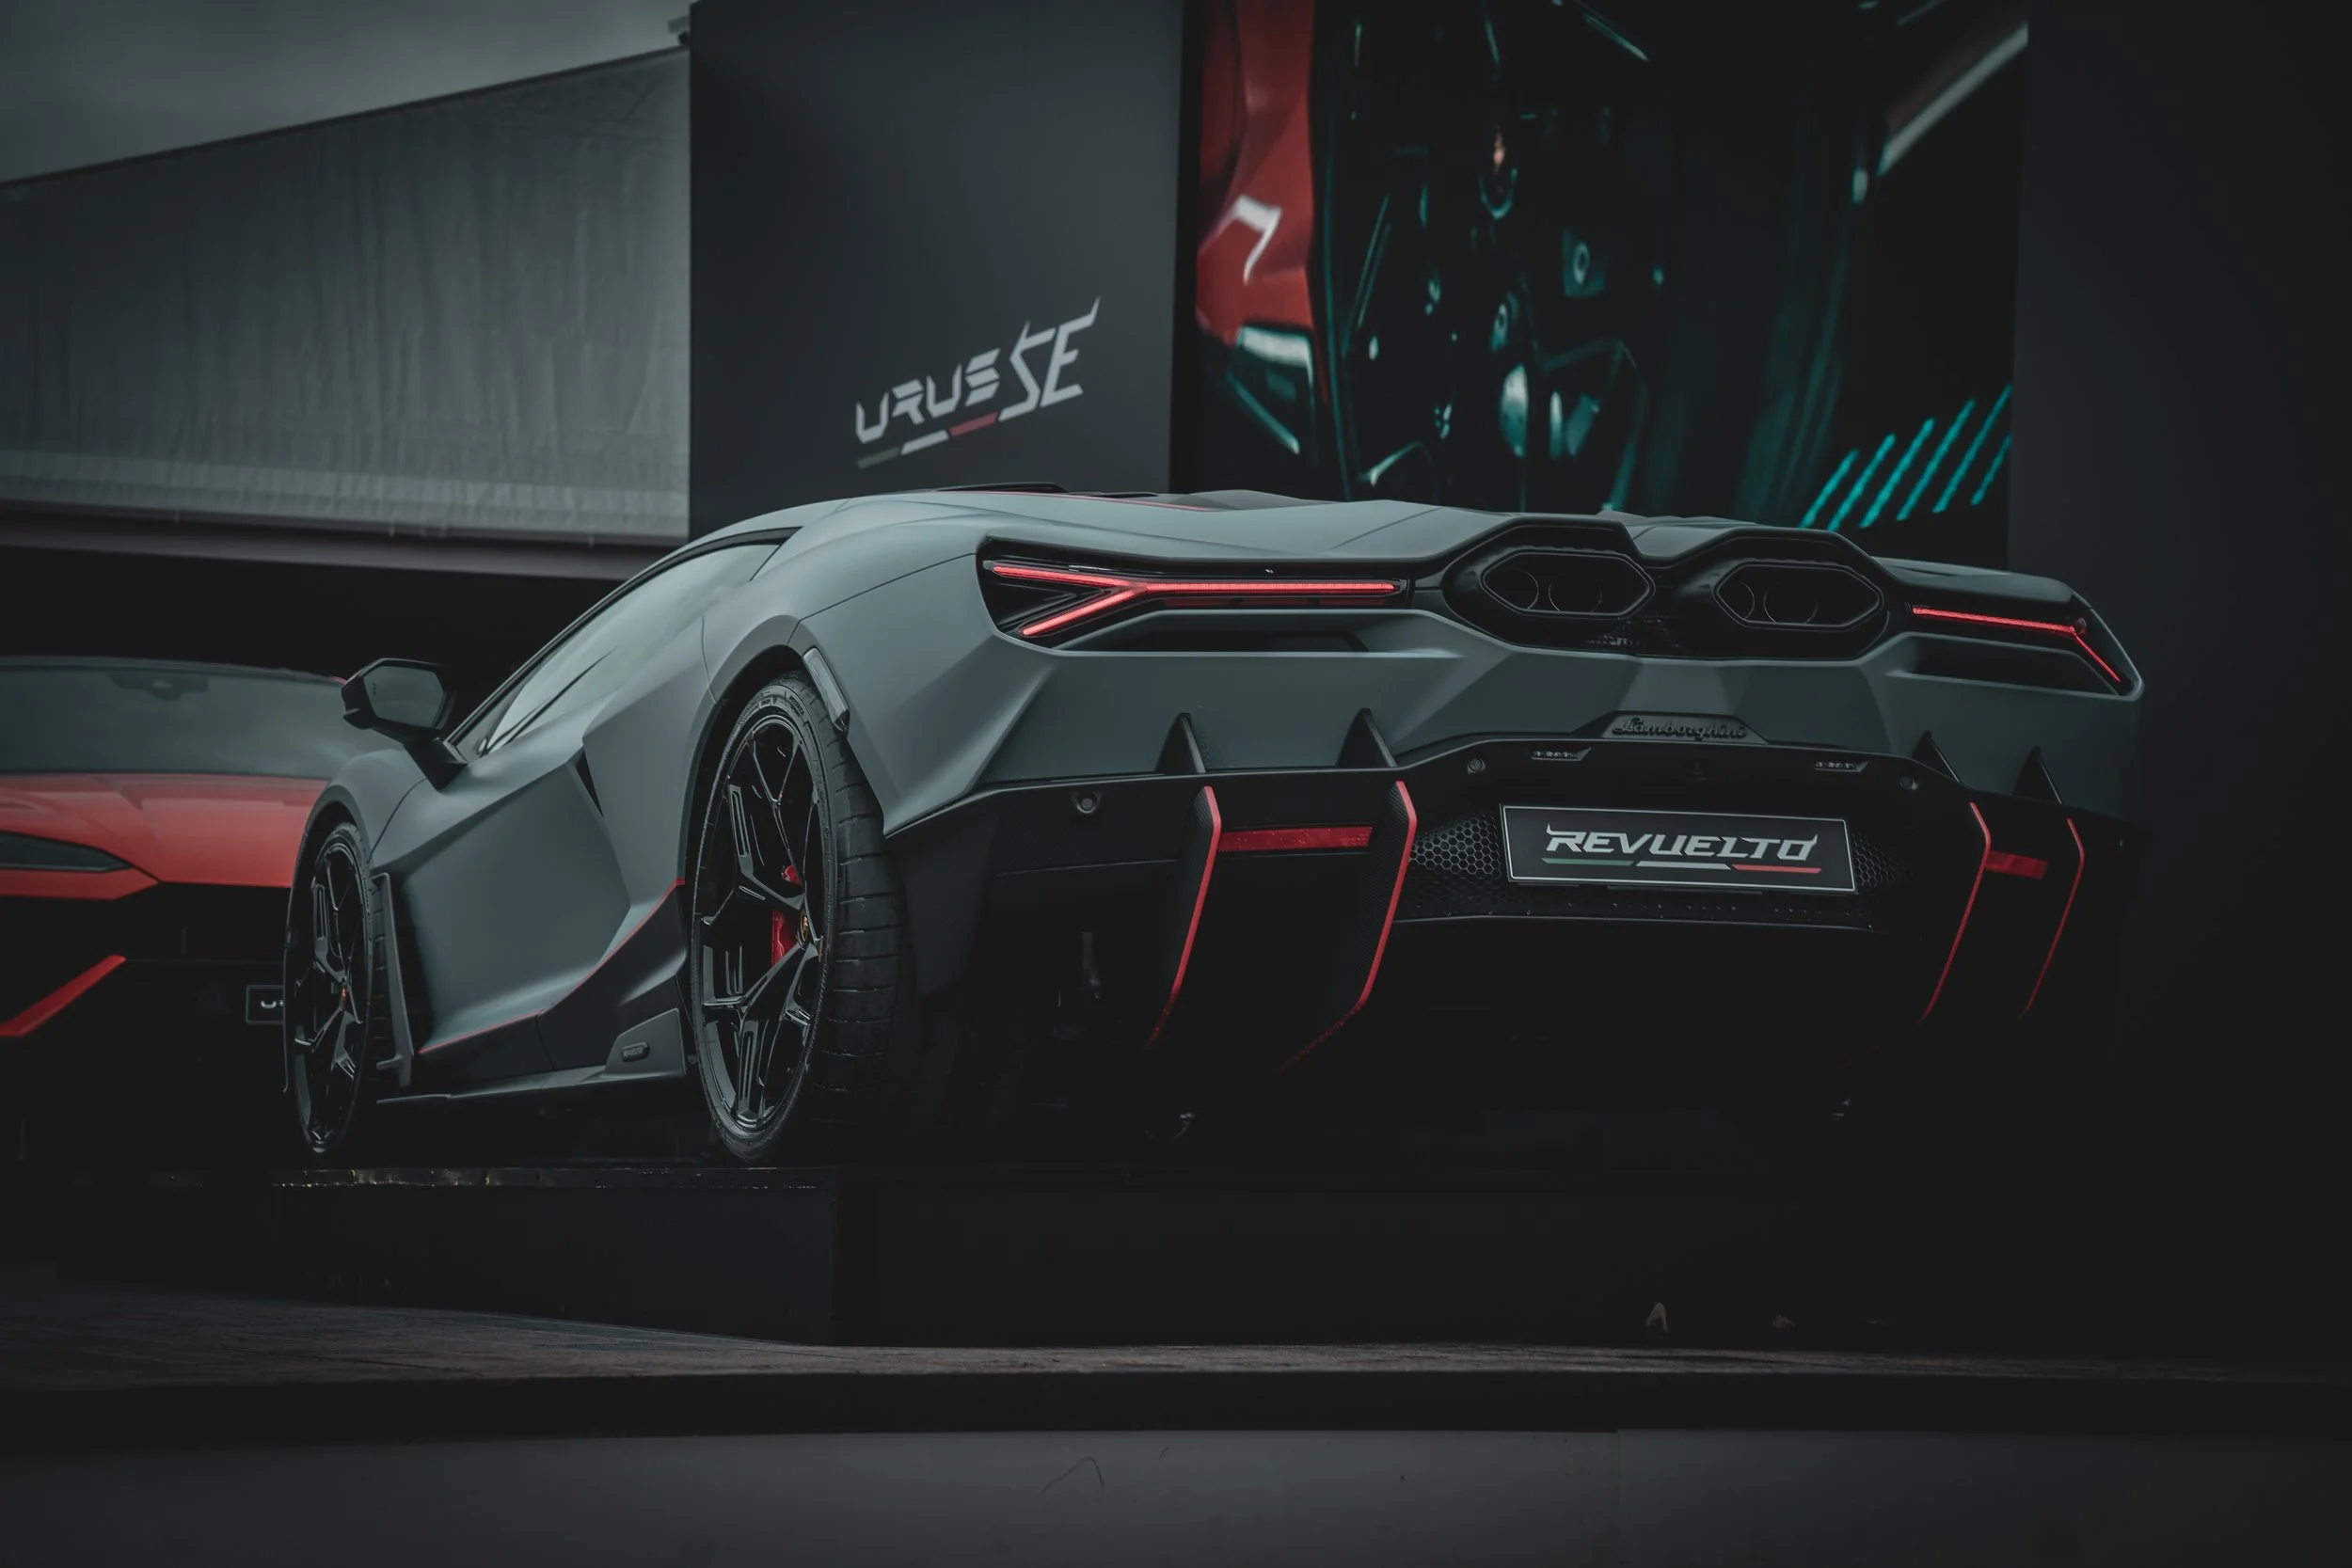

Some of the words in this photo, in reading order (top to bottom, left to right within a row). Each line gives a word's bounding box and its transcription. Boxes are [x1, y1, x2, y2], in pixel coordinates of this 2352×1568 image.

[855, 348, 1001, 444] URUS
[997, 295, 1101, 422] SE
[1612, 717, 1748, 741] Lamborghini
[1546, 823, 1819, 862] REVUELTO
